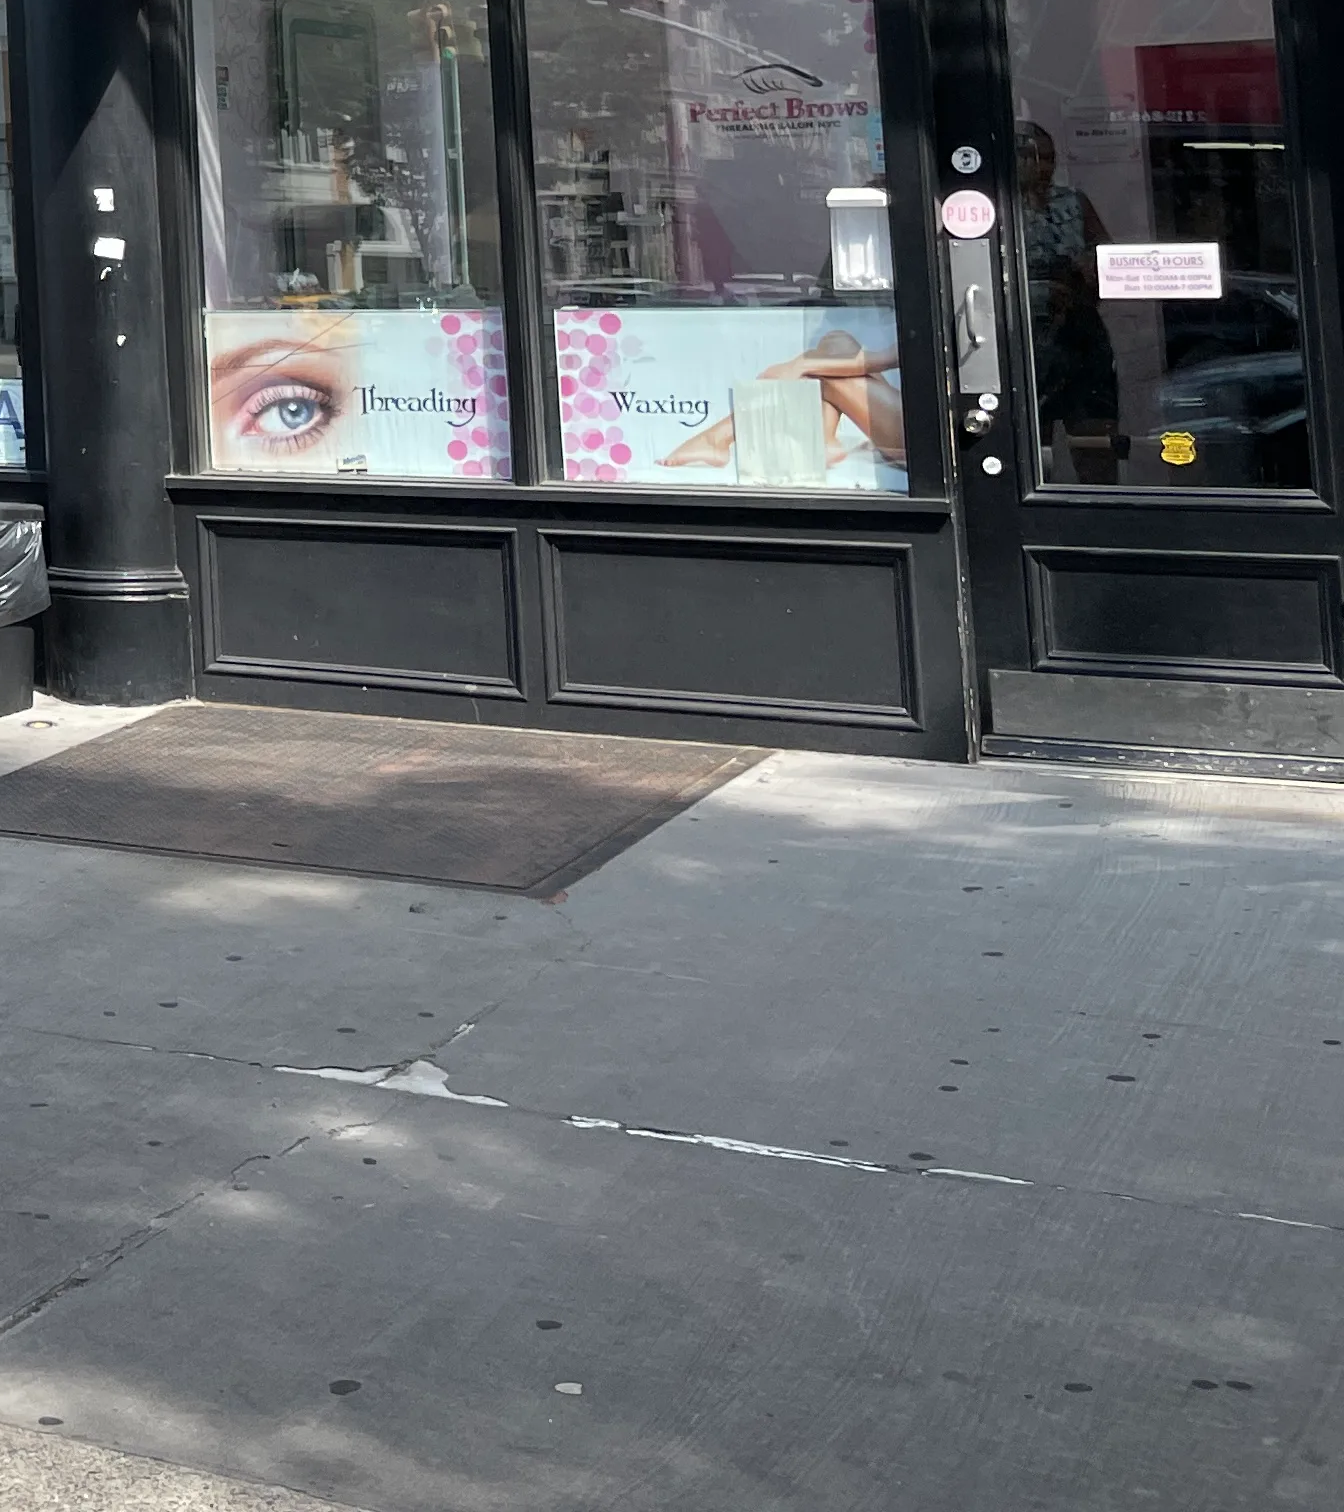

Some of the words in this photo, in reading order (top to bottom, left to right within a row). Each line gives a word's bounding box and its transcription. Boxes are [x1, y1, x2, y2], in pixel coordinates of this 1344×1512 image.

[688, 100, 779, 123] Perfect
[784, 98, 868, 120] Brows
[946, 206, 991, 223] PUSH
[1109, 256, 1159, 267] BUSINESS
[1162, 255, 1204, 267] HOURS
[352, 384, 477, 427] Threading
[608, 391, 710, 427] Waxing
